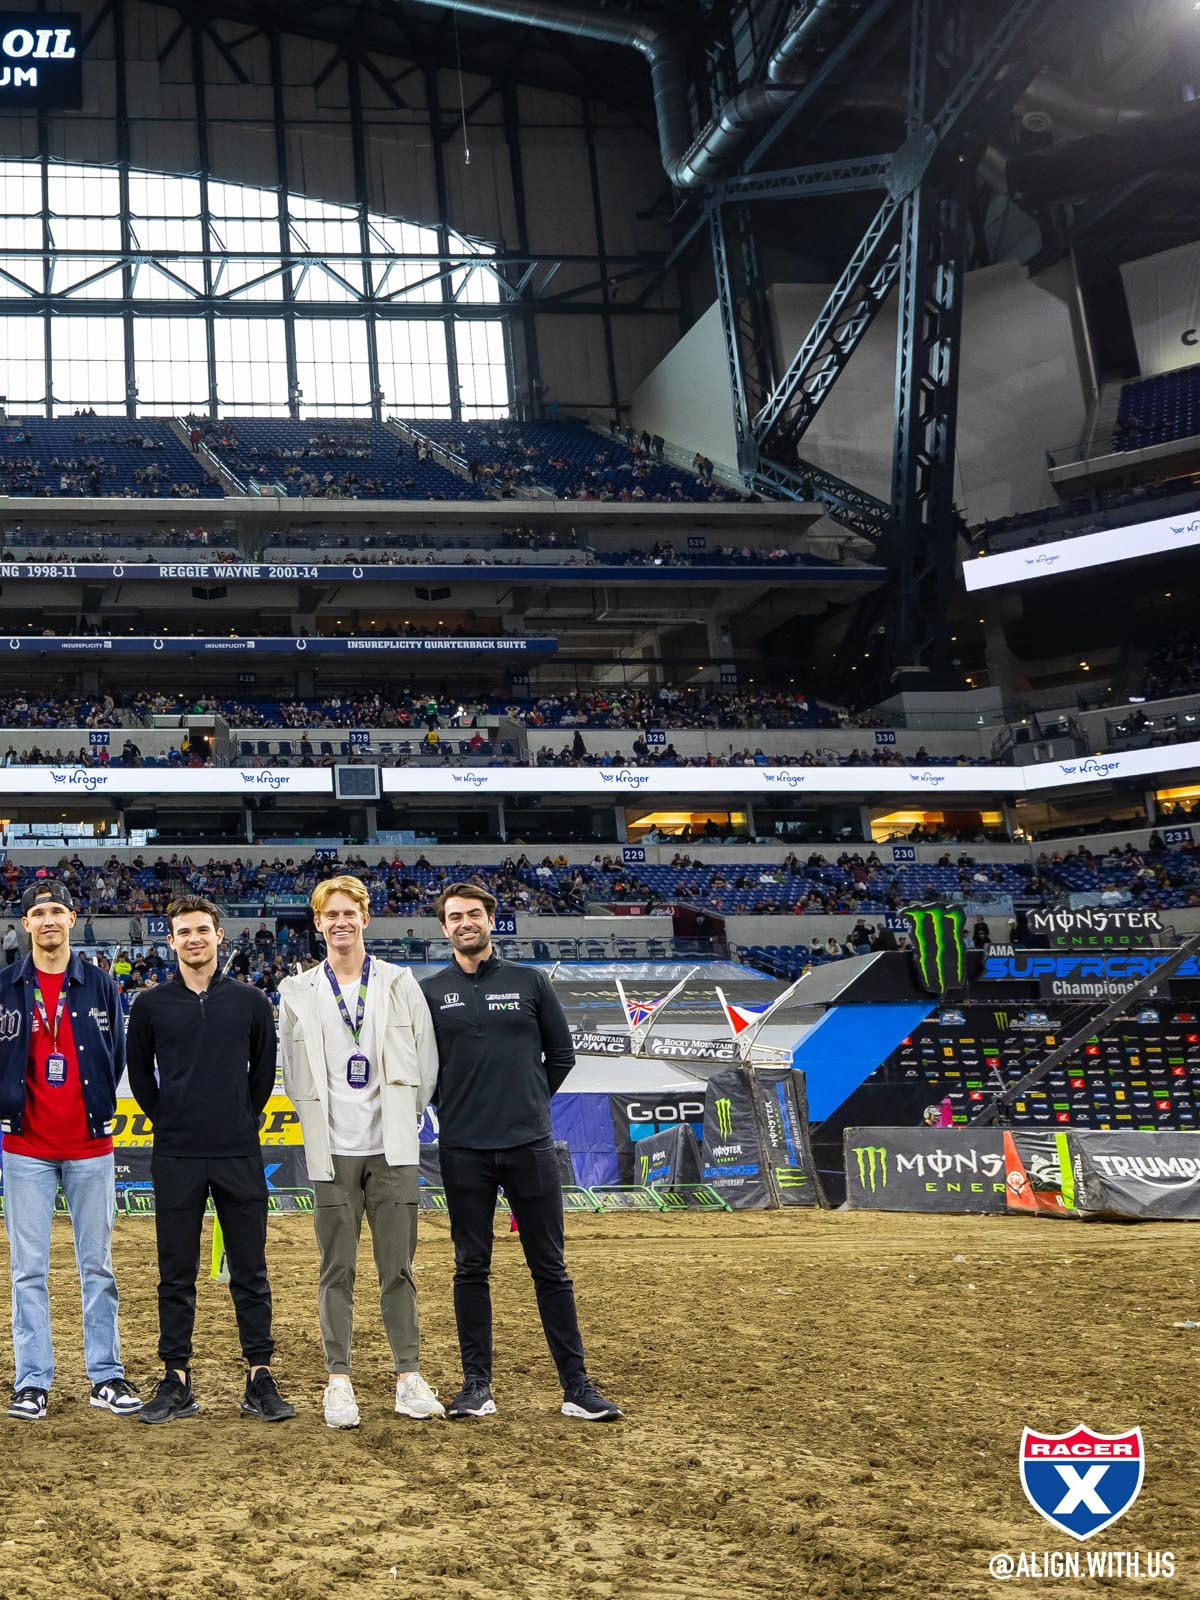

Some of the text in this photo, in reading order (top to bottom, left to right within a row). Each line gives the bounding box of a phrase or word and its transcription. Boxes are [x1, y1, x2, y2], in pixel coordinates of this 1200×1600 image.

[2, 29, 76, 58] OIL
[27, 566, 77, 578] 1998-11
[159, 566, 318, 578] REGGIE WAYNE 2001-14
[347, 641, 527, 650] INSUREPLICITY QUARTERBACK SUITE
[90, 734, 109, 743] 327
[351, 733, 368, 742] 328
[647, 734, 665, 743] 329
[876, 734, 895, 743] 330
[1079, 759, 1120, 777] Kroger
[69, 770, 108, 791] Kroger
[256, 771, 290, 789] Kroger
[615, 770, 650, 789] Kroger
[776, 771, 805, 787] Kroger
[1166, 831, 1190, 842] 231
[624, 850, 644, 860] 229
[894, 849, 914, 858] 230
[888, 917, 910, 929] 129
[1033, 907, 1162, 932] MONSTER
[150, 921, 169, 932] 12
[1055, 935, 1145, 945] ENERGY
[989, 945, 1015, 957] AMA
[440, 1002, 465, 1010] HONDA
[488, 1001, 520, 1010] invst
[583, 1033, 625, 1044] MOUNTAIN
[664, 1038, 734, 1050] ROCKY MOUNTAIN
[712, 1145, 742, 1156] MONSTER
[896, 1150, 1005, 1178] MONS
[1093, 1156, 1200, 1179] TRIUMP
